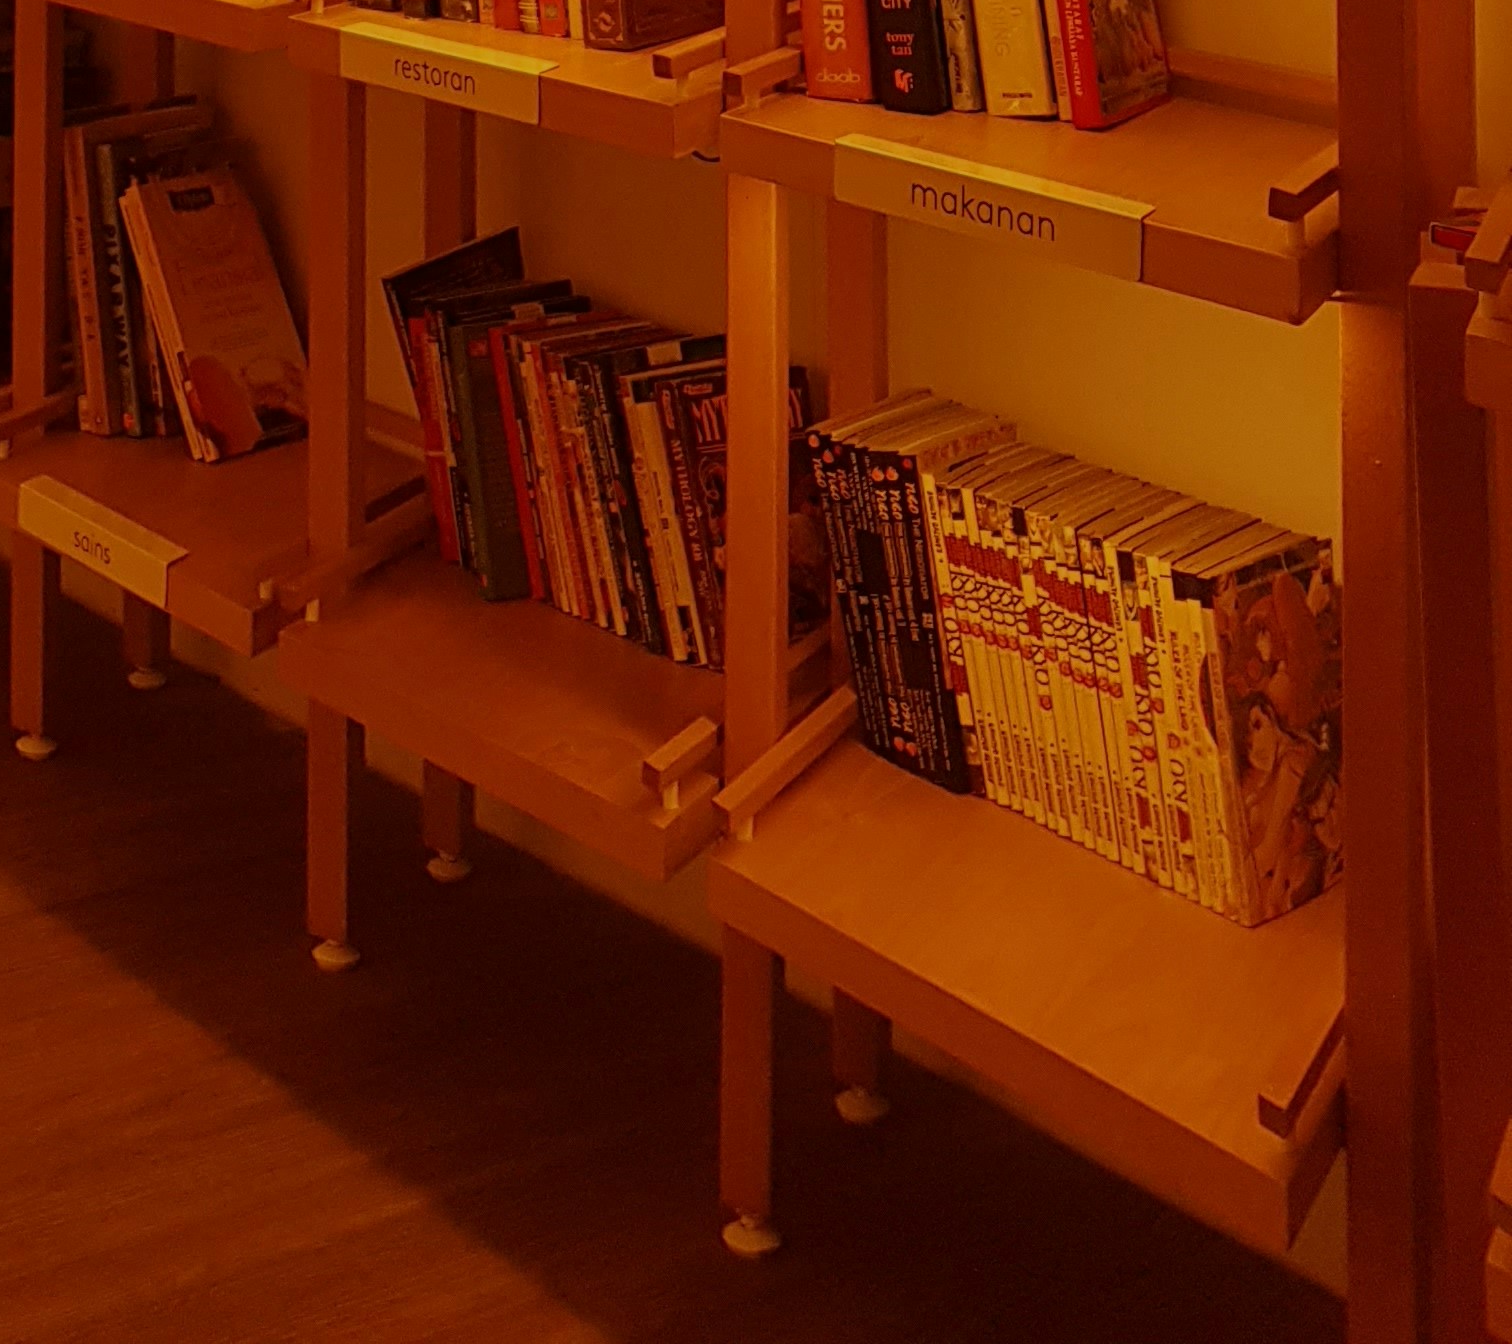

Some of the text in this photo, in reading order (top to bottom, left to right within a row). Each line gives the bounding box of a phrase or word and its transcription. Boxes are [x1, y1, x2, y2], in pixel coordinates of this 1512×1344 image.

[885, 33, 915, 48] tony
[890, 44, 913, 57] tan
[393, 57, 476, 96] restoran
[911, 183, 1055, 242] makanan
[73, 531, 111, 565] sains
